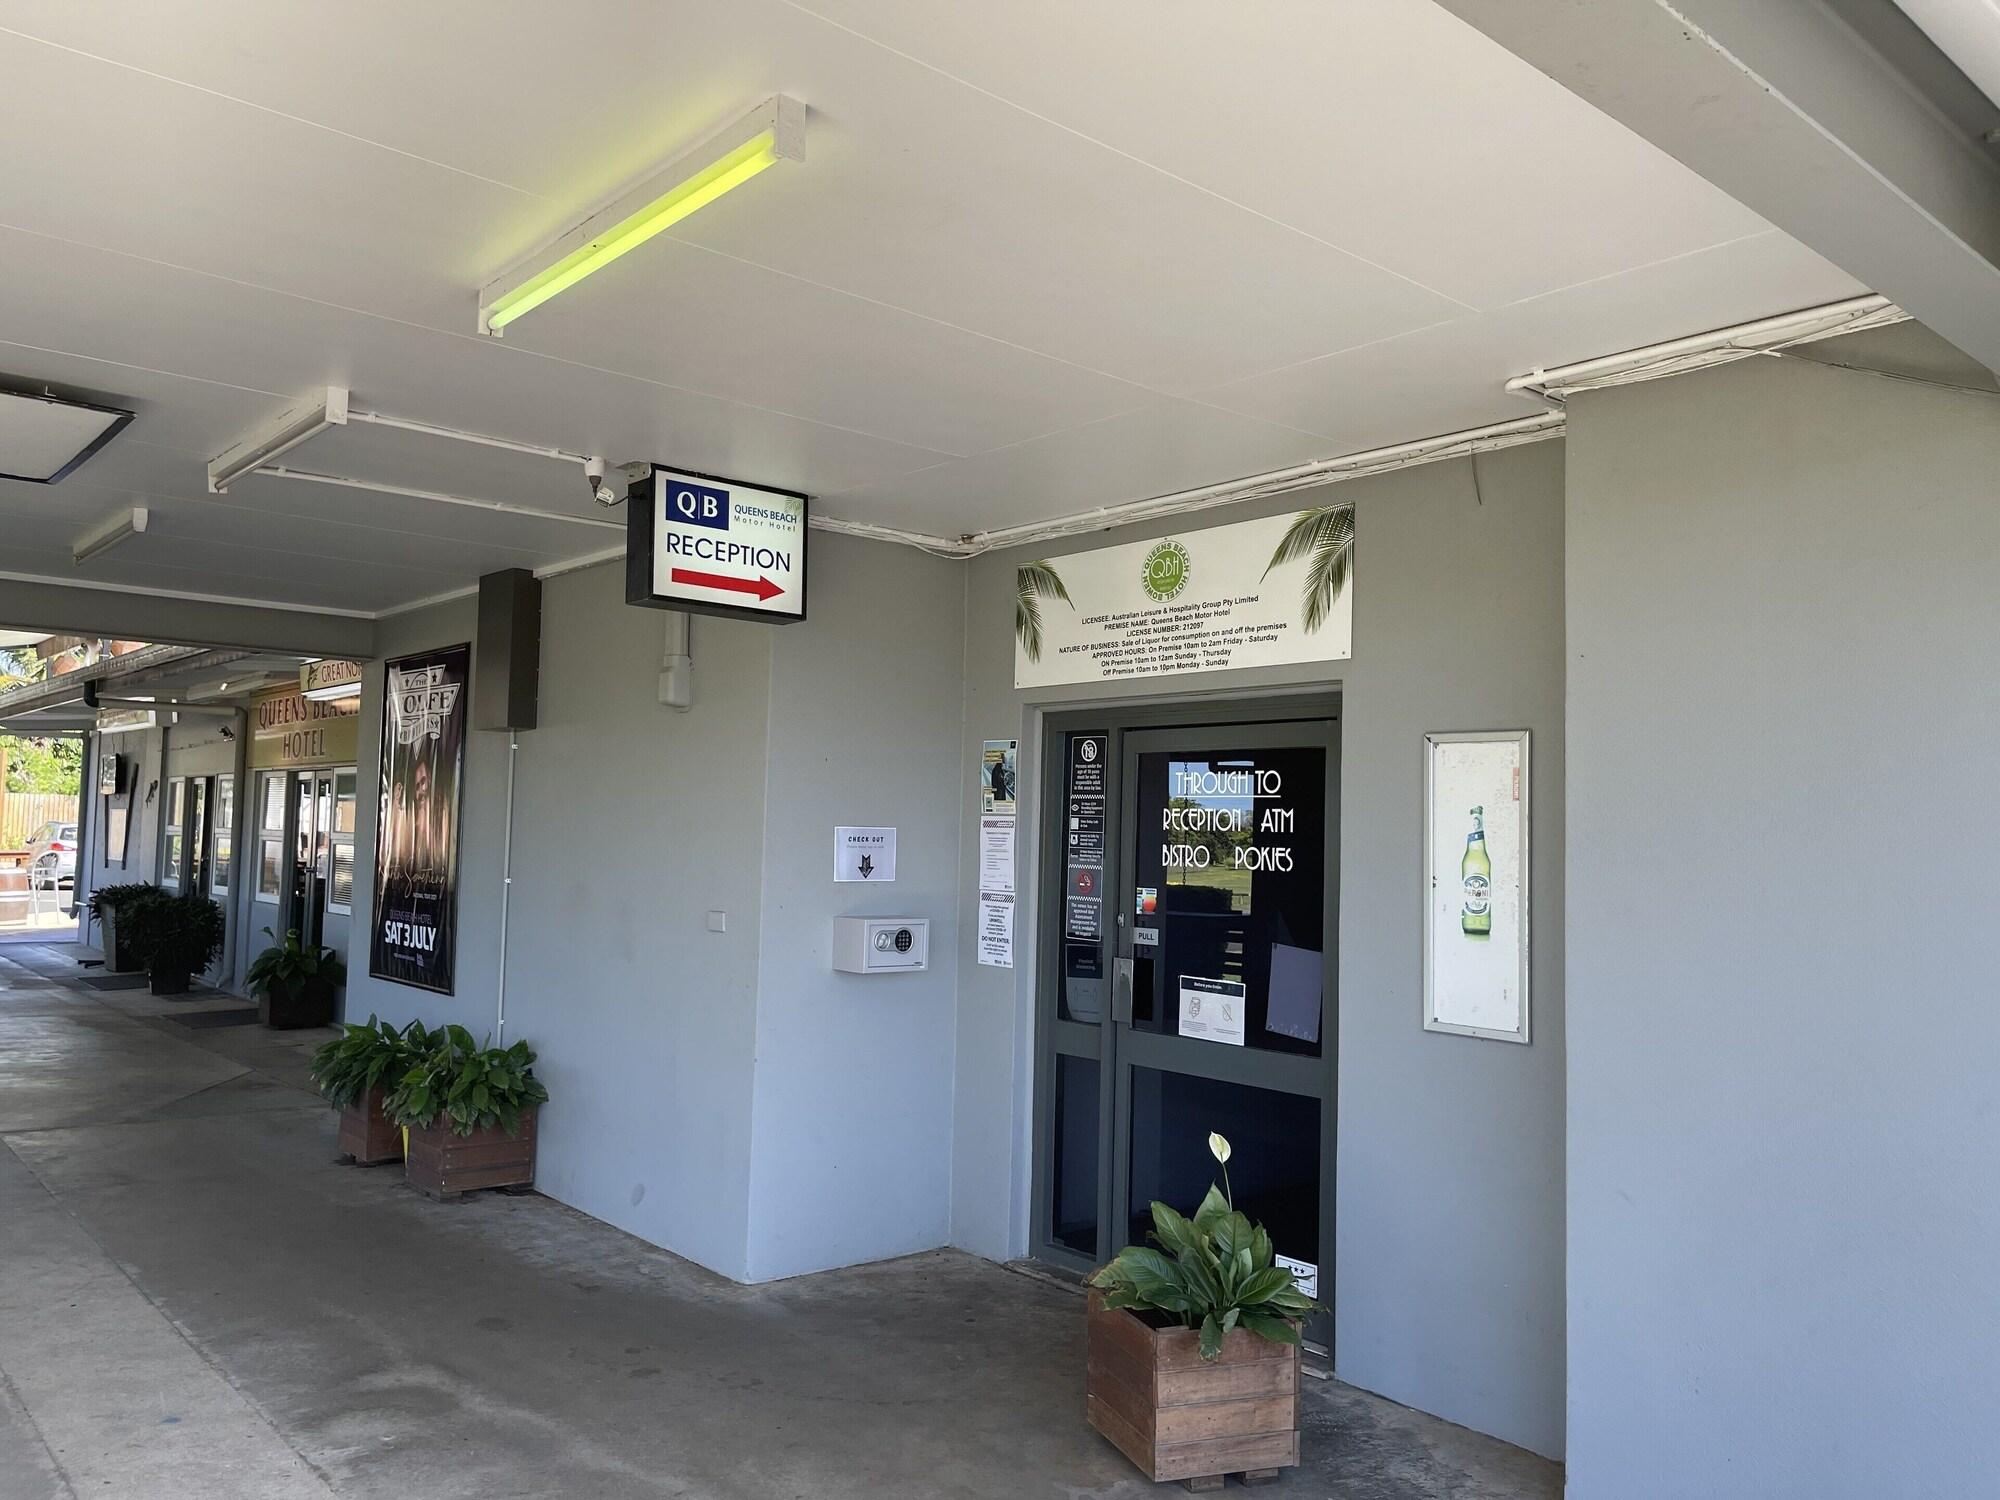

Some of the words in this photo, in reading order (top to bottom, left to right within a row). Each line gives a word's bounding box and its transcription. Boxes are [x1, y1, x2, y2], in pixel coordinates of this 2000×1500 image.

[734, 504, 768, 519] QUEENS
[770, 510, 797, 524] BEACH
[734, 515, 764, 527] Motor
[770, 522, 796, 532] Hotel
[666, 532, 791, 572] RECEPTION
[1144, 543, 1172, 570] QUEENS
[1173, 544, 1190, 572] BEACH
[1142, 576, 1163, 600] BOWEN
[1165, 576, 1188, 600] HOTEL
[1081, 615, 1110, 625] LICENSEE:
[1112, 612, 1140, 620] Australian
[1140, 608, 1162, 617] Leisure
[1169, 604, 1200, 614] Hospitality
[1202, 600, 1222, 609] Group
[1222, 598, 1234, 607] Pty
[1234, 595, 1259, 604] Limited
[1104, 622, 1130, 631] PREMISE
[1130, 619, 1150, 628] NAME:
[1151, 617, 1174, 625] Queens
[1174, 614, 1194, 622] Beach
[1194, 611, 1214, 620] Motor
[1214, 609, 1230, 617] Hotel
[1059, 646, 1081, 654] NATURE
[1082, 644, 1090, 652] OF
[1090, 642, 1120, 651] BUSINESS:
[1122, 640, 1134, 648] Sale
[1142, 637, 1160, 646] Liquor
[1172, 631, 1210, 642] consumption
[1221, 627, 1234, 636] and
[1234, 626, 1244, 634] off
[1244, 624, 1255, 632] the
[1256, 622, 1288, 633] premises
[1126, 628, 1152, 638] LICENSE
[1152, 625, 1182, 634] NUMBER:
[1182, 622, 1204, 630] 212097
[1092, 650, 1124, 660] APPROVED
[1124, 647, 1146, 656] HOURS:
[1158, 644, 1182, 653] Premise
[1184, 642, 1200, 650] 10am
[1208, 639, 1222, 647] 2am
[1223, 637, 1243, 646] Friday
[1248, 634, 1279, 643] Saturday
[1101, 660, 1110, 668] ON
[1110, 658, 1134, 666] Premise
[1134, 656, 1150, 664] 10am
[1158, 654, 1174, 662] 12am
[1174, 651, 1198, 660] Sunday
[1202, 648, 1232, 658] Thursday
[322, 662, 344, 682] GREAT
[1103, 668, 1112, 676] Off
[1112, 666, 1135, 676] Premise
[1136, 665, 1151, 673] 10am
[1160, 663, 1176, 672] 10pm
[1176, 660, 1200, 670] Monday
[1206, 658, 1229, 668] Sunday
[259, 695, 308, 729] QUEENS
[312, 699, 360, 721] BEA
[401, 690, 455, 714] OLFE
[282, 728, 326, 759] HOTEL
[1176, 770, 1249, 794] THROUGH
[1255, 770, 1282, 794] TO
[1162, 808, 1242, 832] RECEPTION
[1261, 808, 1294, 833] ATM
[1162, 844, 1210, 868] BISTRO
[1235, 846, 1294, 872] POKIES
[384, 920, 403, 946] SAT
[403, 924, 410, 946] 3
[410, 924, 437, 952] JULY
[1138, 932, 1155, 940] PULL
